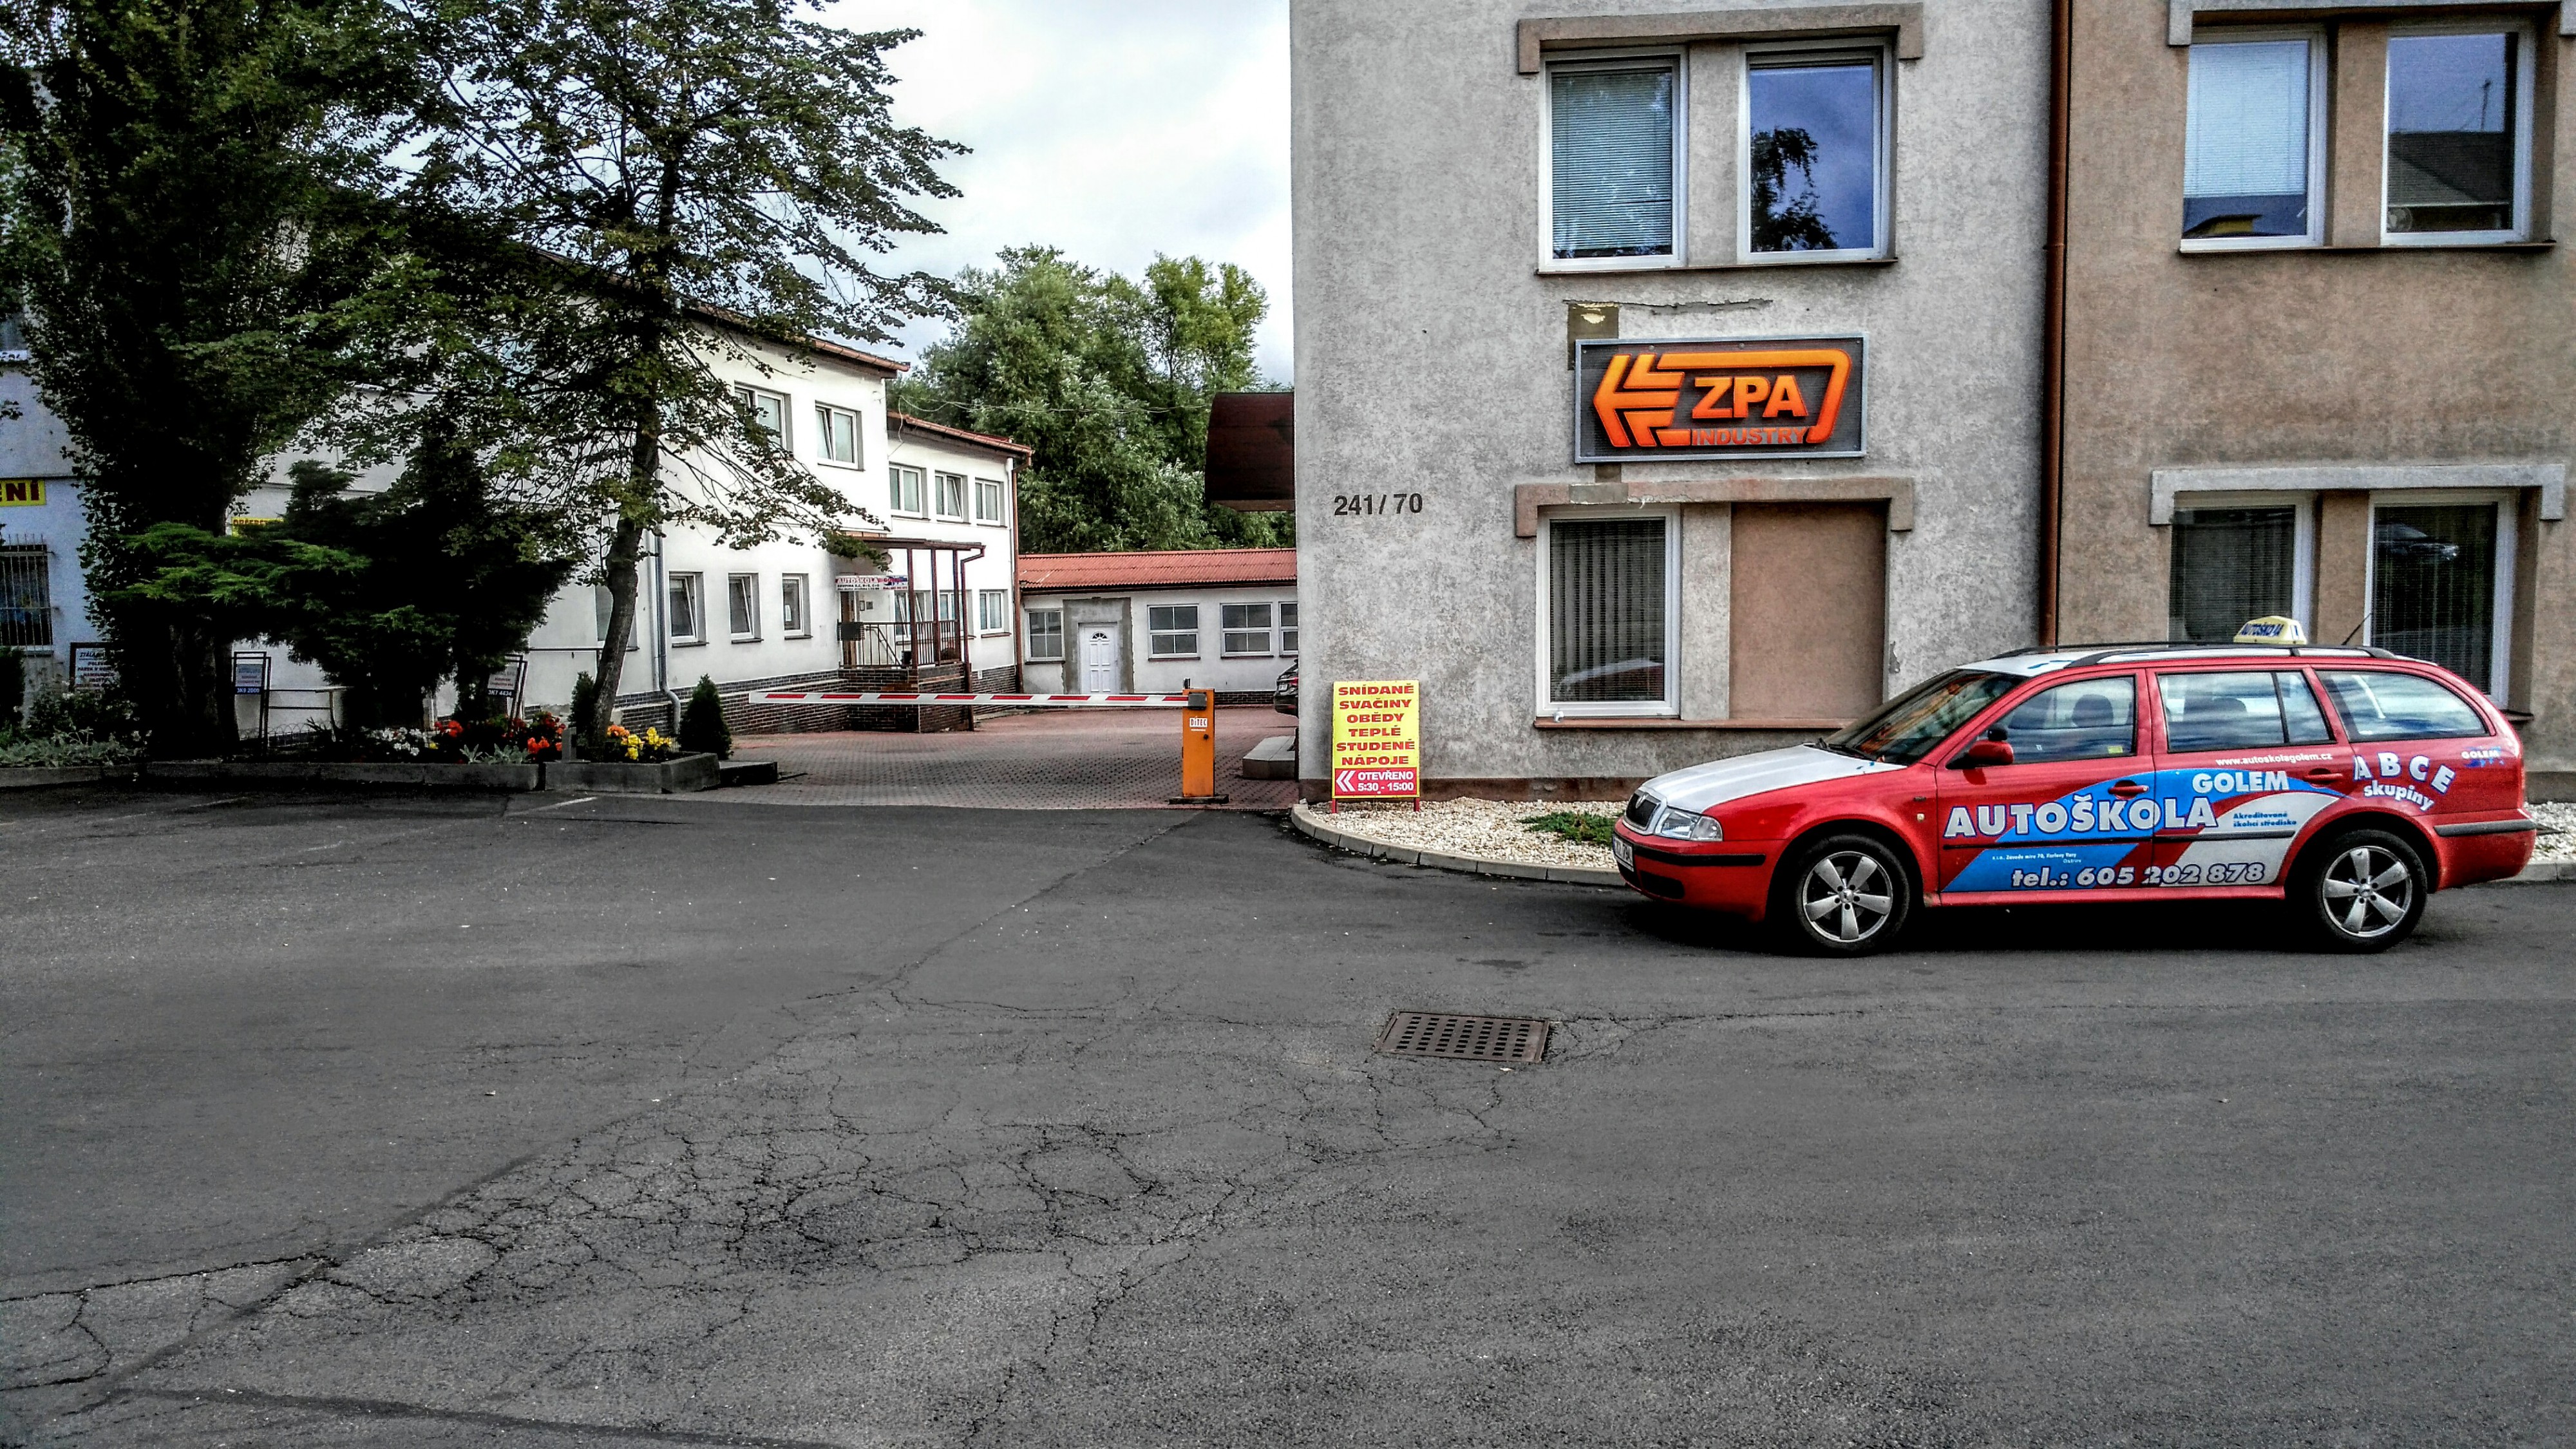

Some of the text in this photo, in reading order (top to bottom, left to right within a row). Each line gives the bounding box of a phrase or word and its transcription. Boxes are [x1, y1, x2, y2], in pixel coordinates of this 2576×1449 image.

[1692, 374, 1808, 419] ZPA
[1691, 426, 1805, 446] INDUSTRY
[1338, 683, 1414, 695] SNÍDANĚ
[1340, 698, 1412, 709] SVAČINY
[1347, 712, 1405, 723] OBĚDY
[1349, 725, 1401, 737] TEPLÉ
[1336, 739, 1415, 751] STUDENÉ
[1341, 754, 1408, 765] NÁPOJE
[2215, 753, 2333, 766] www.autoskolagolem.cz
[2461, 750, 2499, 759] GOLEM
[1358, 770, 1414, 781] OTEVŘENO
[1387, 782, 1414, 791] 15:00
[2192, 771, 2289, 793] GOLEM
[2363, 780, 2434, 811] skupiny
[1944, 793, 2219, 838] AUTOŠKOLA
[2012, 862, 2265, 887] tel.: 605 202 878
